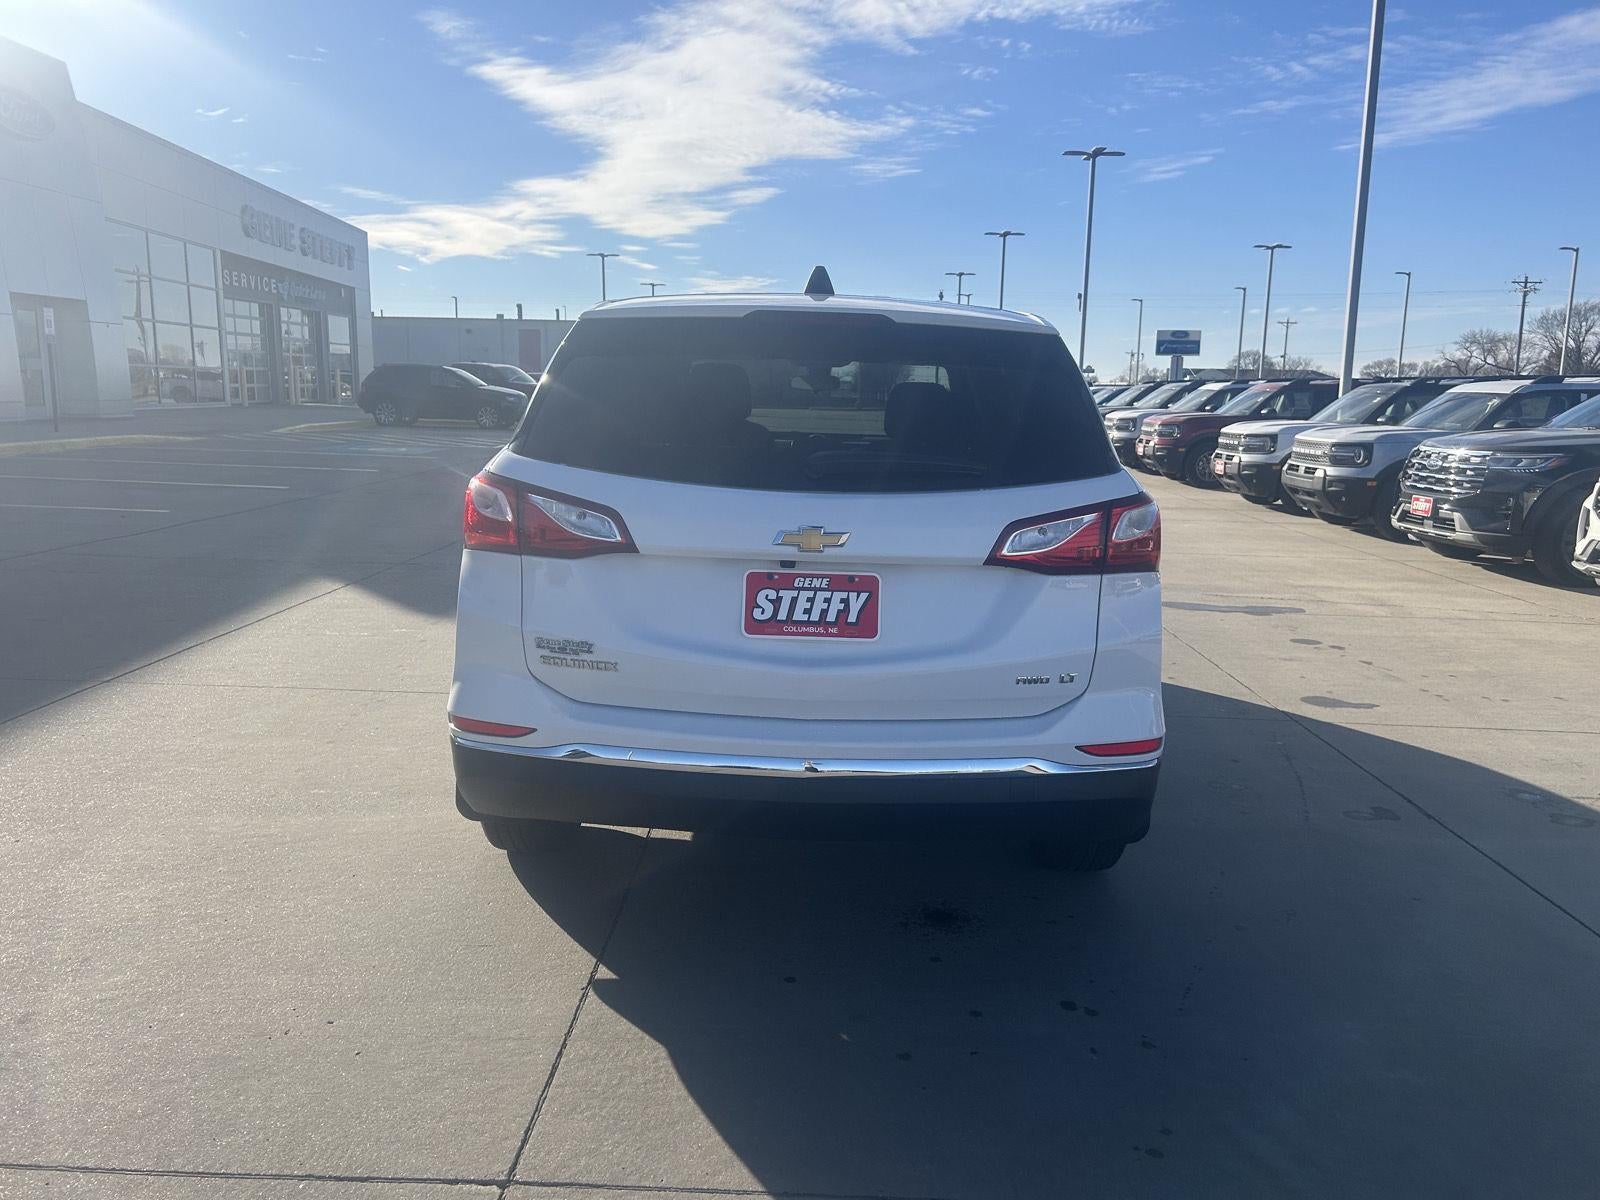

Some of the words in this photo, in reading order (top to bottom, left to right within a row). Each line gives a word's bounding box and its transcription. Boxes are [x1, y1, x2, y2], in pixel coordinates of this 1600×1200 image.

[223, 269, 278, 293] SERVICE
[794, 577, 830, 588] GENE
[752, 588, 870, 623] STEFFY
[783, 626, 826, 634] COLUMBUS,
[540, 655, 619, 672] EQUINOX
[1016, 675, 1050, 685] AWD
[1058, 673, 1078, 684] LT
